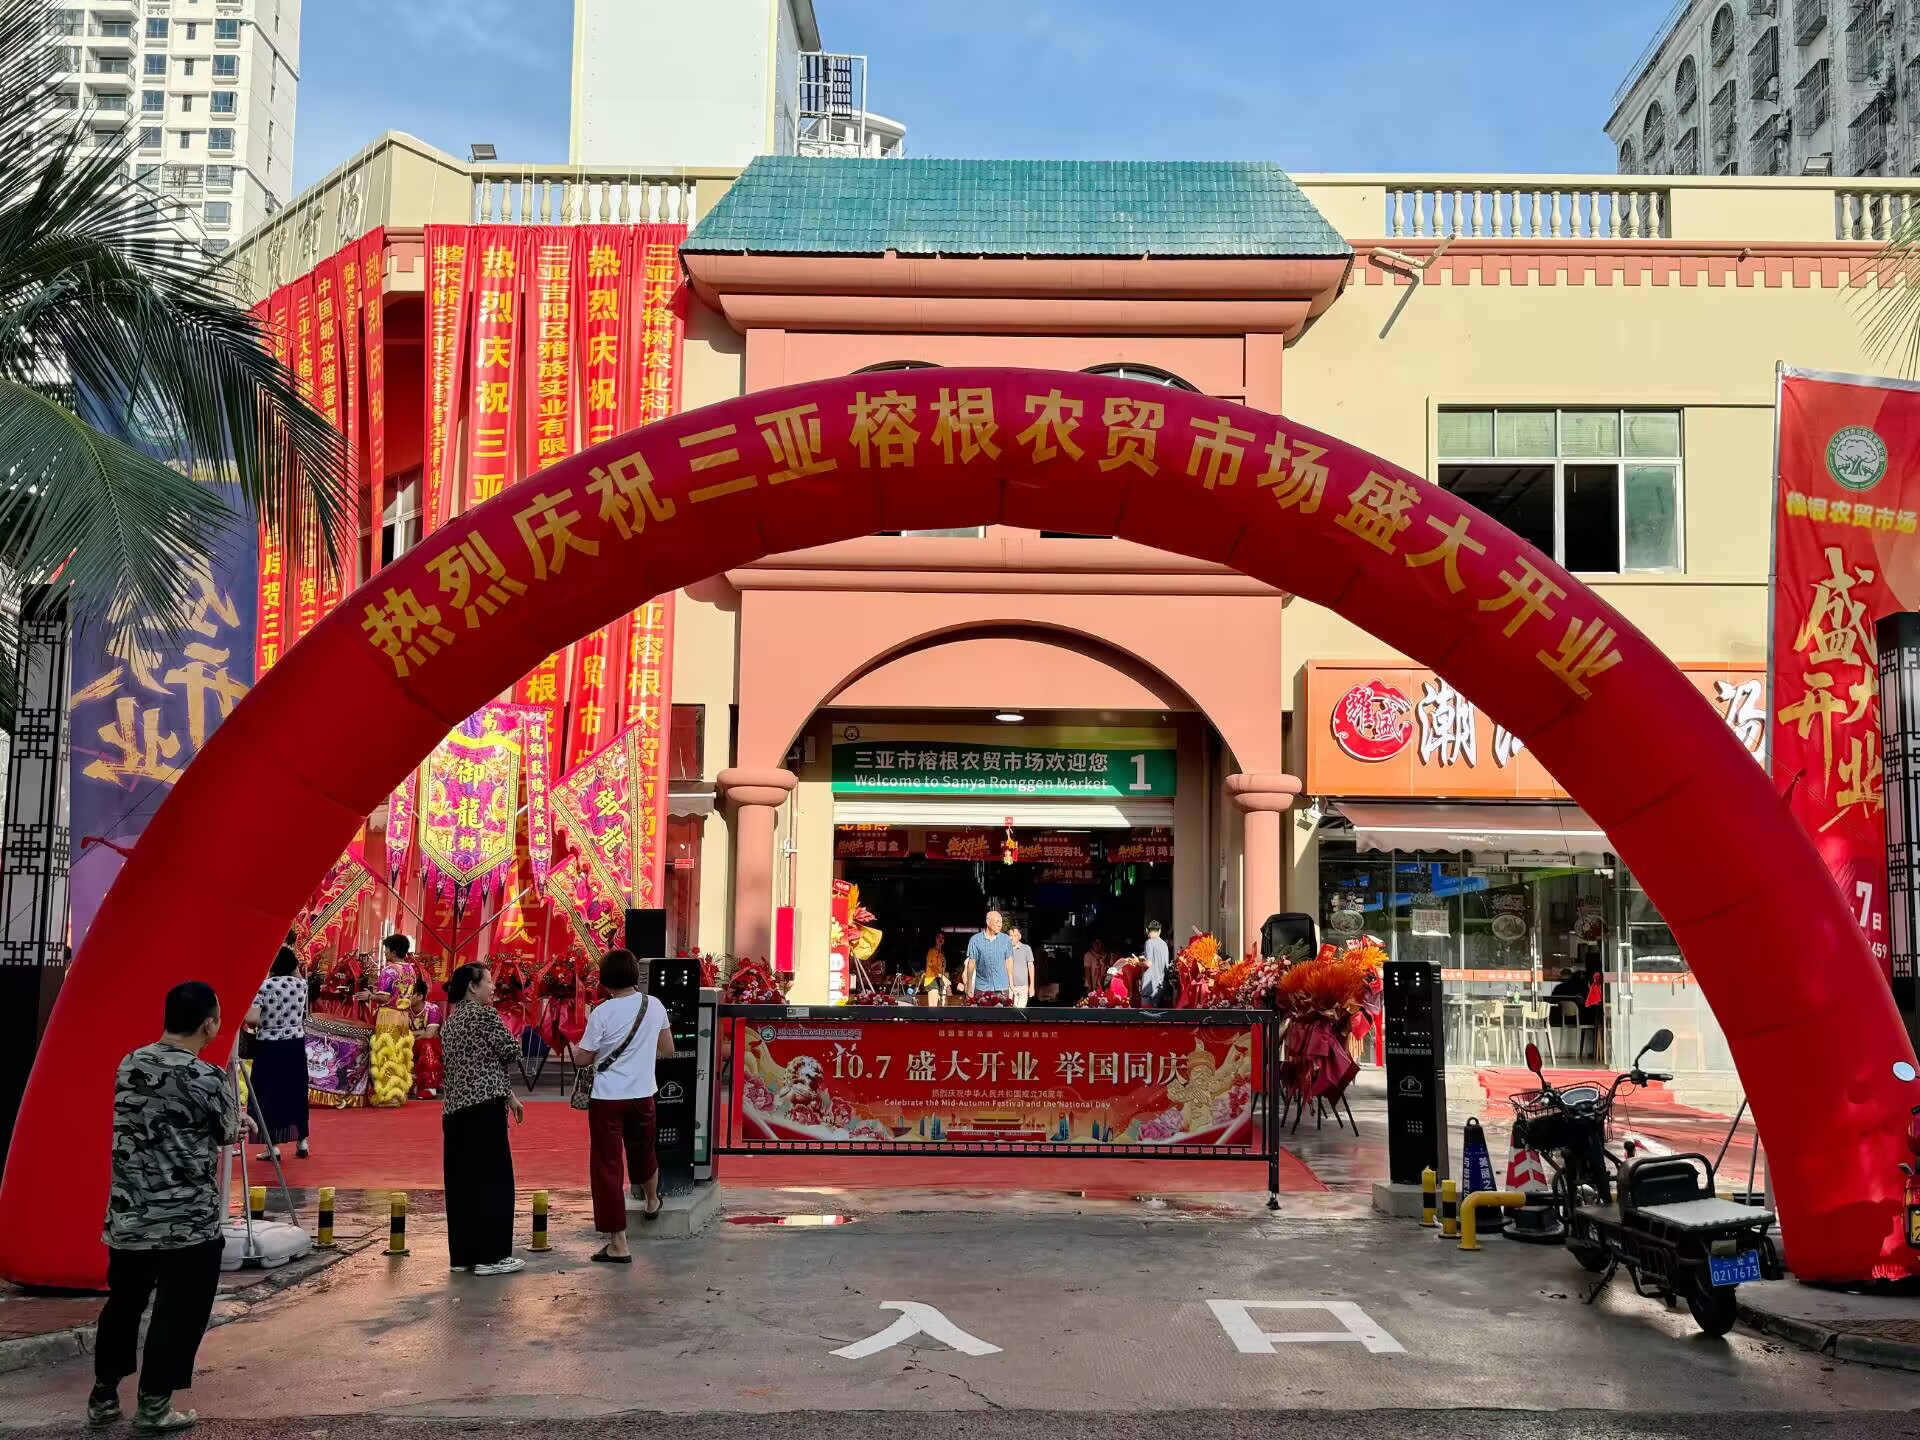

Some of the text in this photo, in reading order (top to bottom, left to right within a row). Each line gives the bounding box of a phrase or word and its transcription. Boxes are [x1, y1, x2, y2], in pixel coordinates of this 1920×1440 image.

[361, 386, 1623, 700] 热烈庆祝三亚榕根农贸市场盛大开业
[854, 750, 1152, 790] 三亚市榕根农贸市场欢迎您 1
[854, 774, 1108, 792] Welcome to Sanya Ronggen Market
[832, 1050, 1189, 1086] 10.7 盛大开业 举国同庆
[884, 1099, 924, 1107] Celebrate
[926, 1099, 940, 1107] the
[942, 1099, 990, 1107] Mid-Autumn
[992, 1100, 1024, 1108] Festival
[1059, 1101, 1093, 1109] National
[1096, 1101, 1111, 1110] Day
[1713, 1265, 1759, 1282] 0217673
